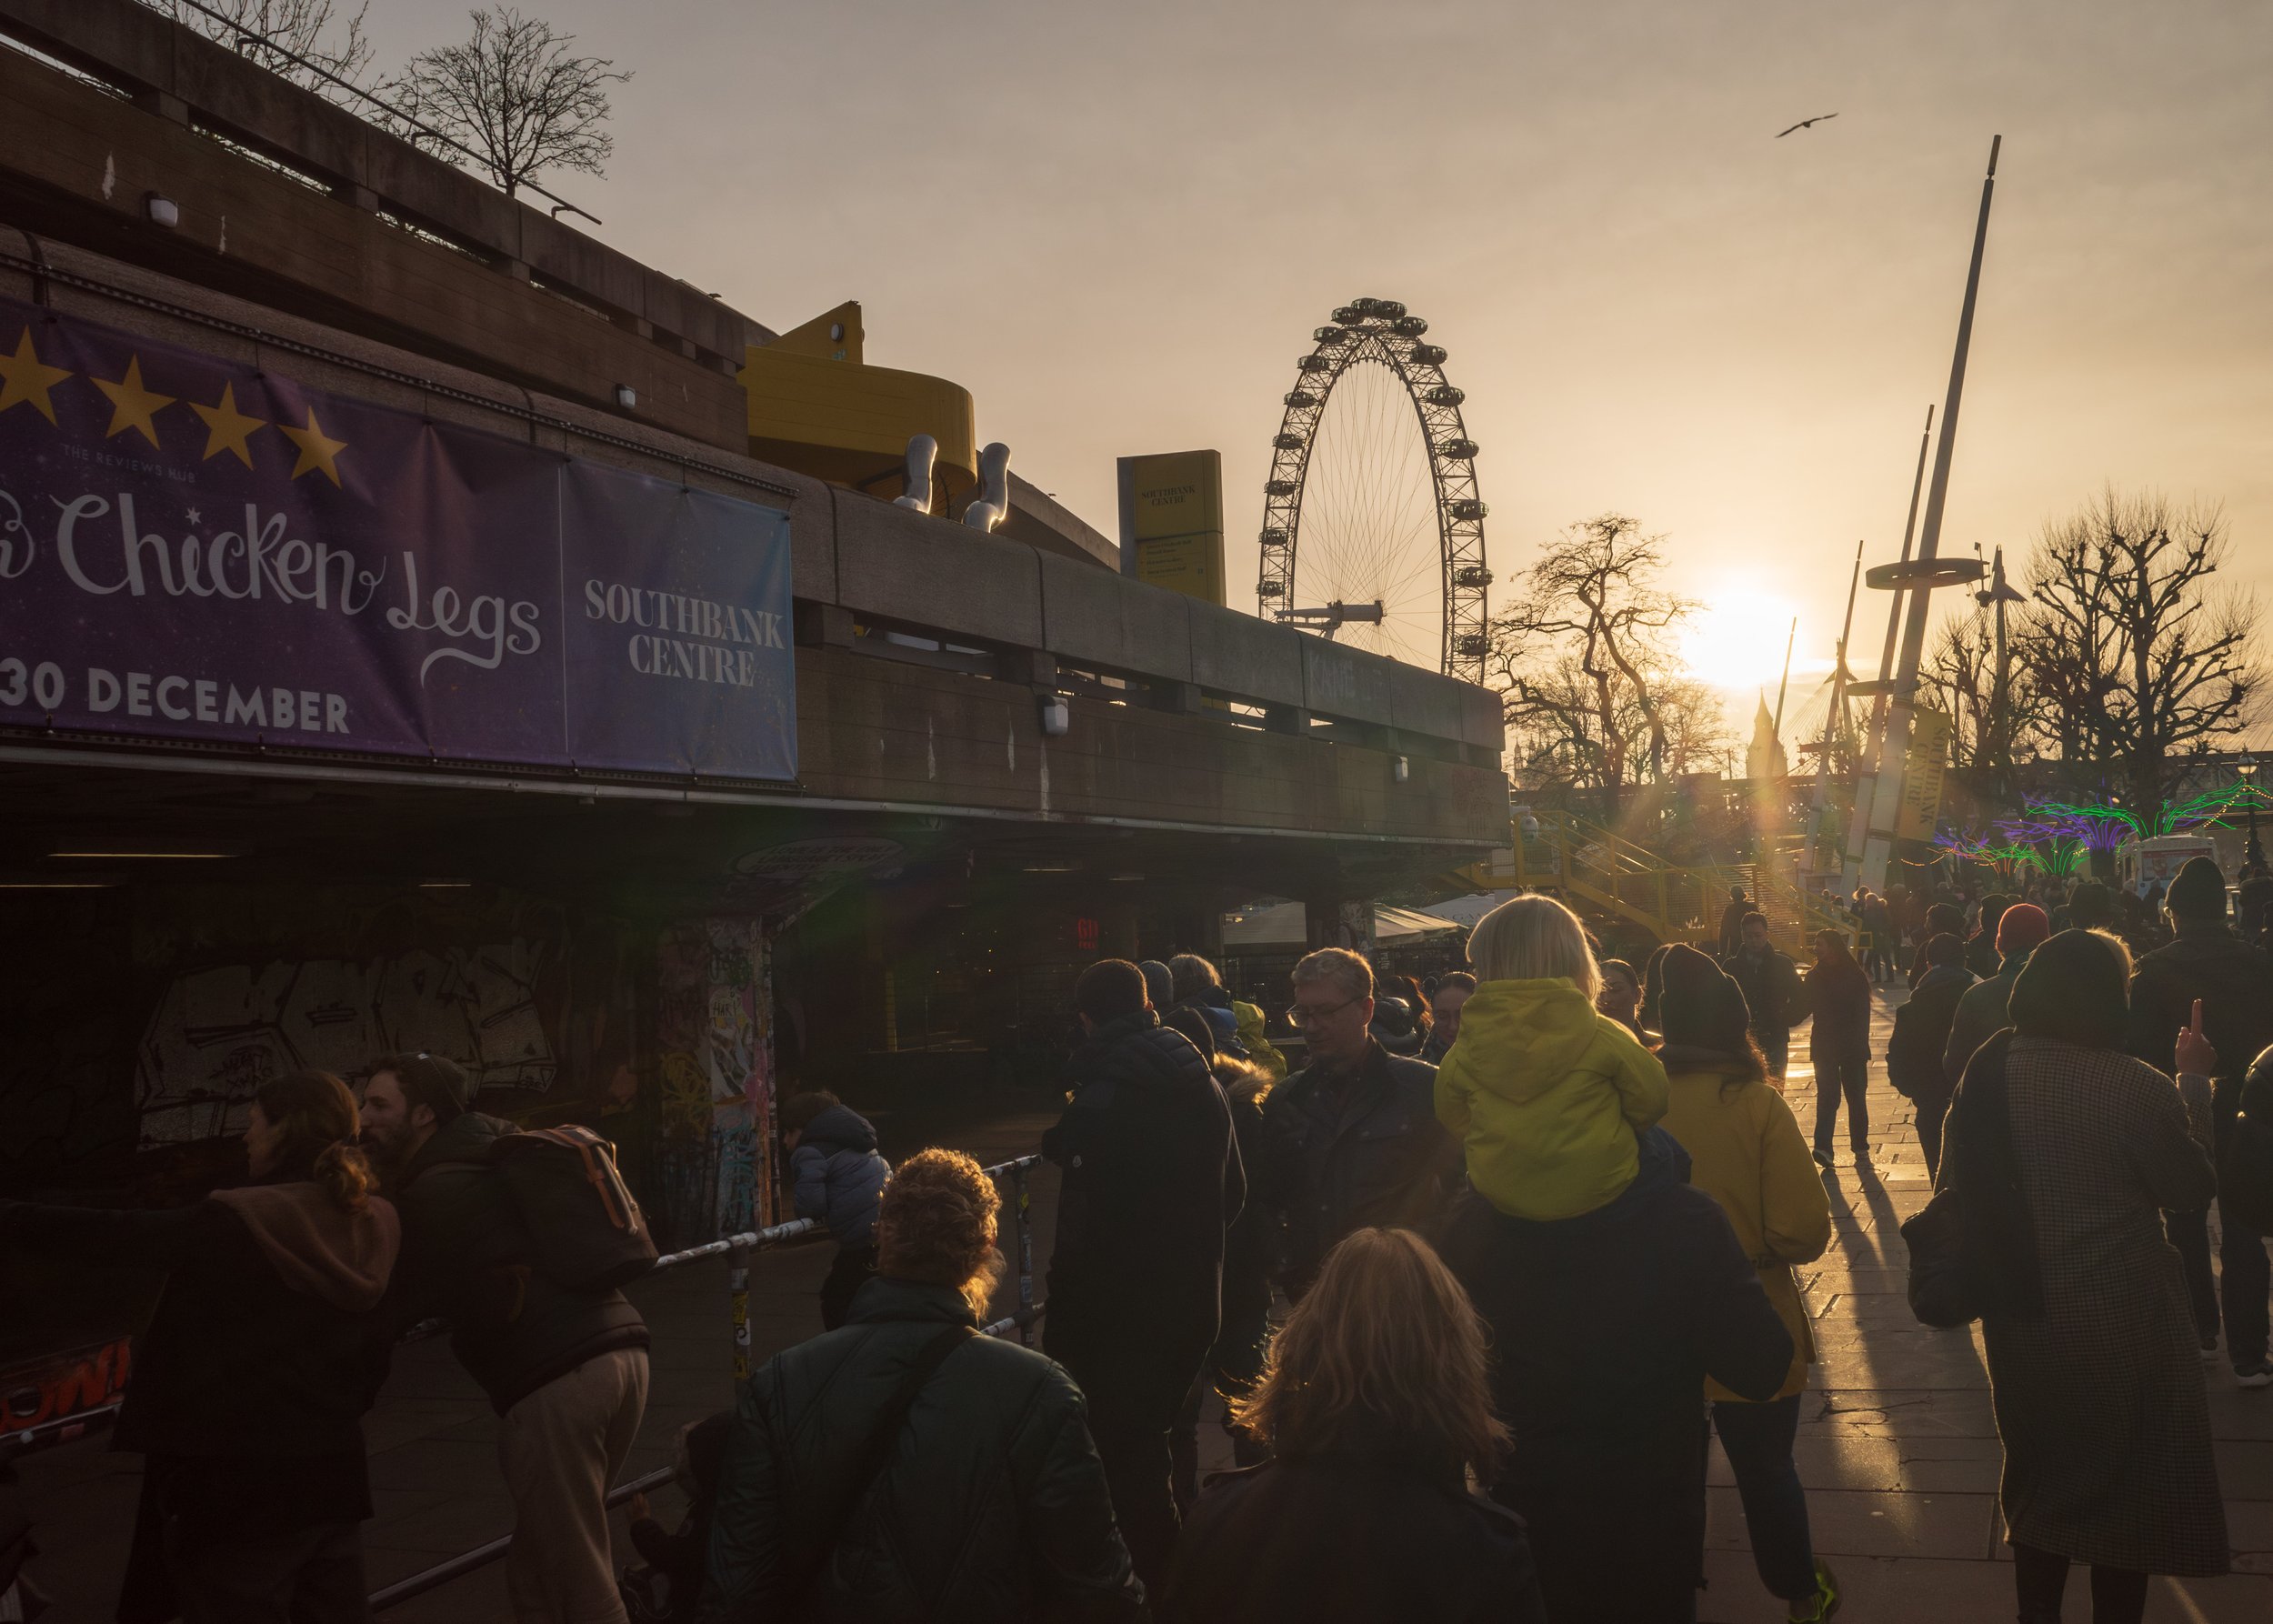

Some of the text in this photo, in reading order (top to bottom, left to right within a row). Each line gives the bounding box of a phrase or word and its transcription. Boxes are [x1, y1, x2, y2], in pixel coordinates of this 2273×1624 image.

[60, 442, 196, 485] THE REVIEWS HUB
[1141, 484, 1196, 499] SOUTHBANK
[1151, 494, 1186, 507] CENTRE
[48, 493, 386, 615] Chicken
[386, 551, 541, 689] Legs
[585, 579, 786, 649] SOUTHBANK
[629, 634, 756, 687] CENTRE
[88, 667, 350, 734] DECEMBER
[1907, 742, 1929, 807] CENTRE
[1919, 726, 1948, 824] SOUTHBANK
